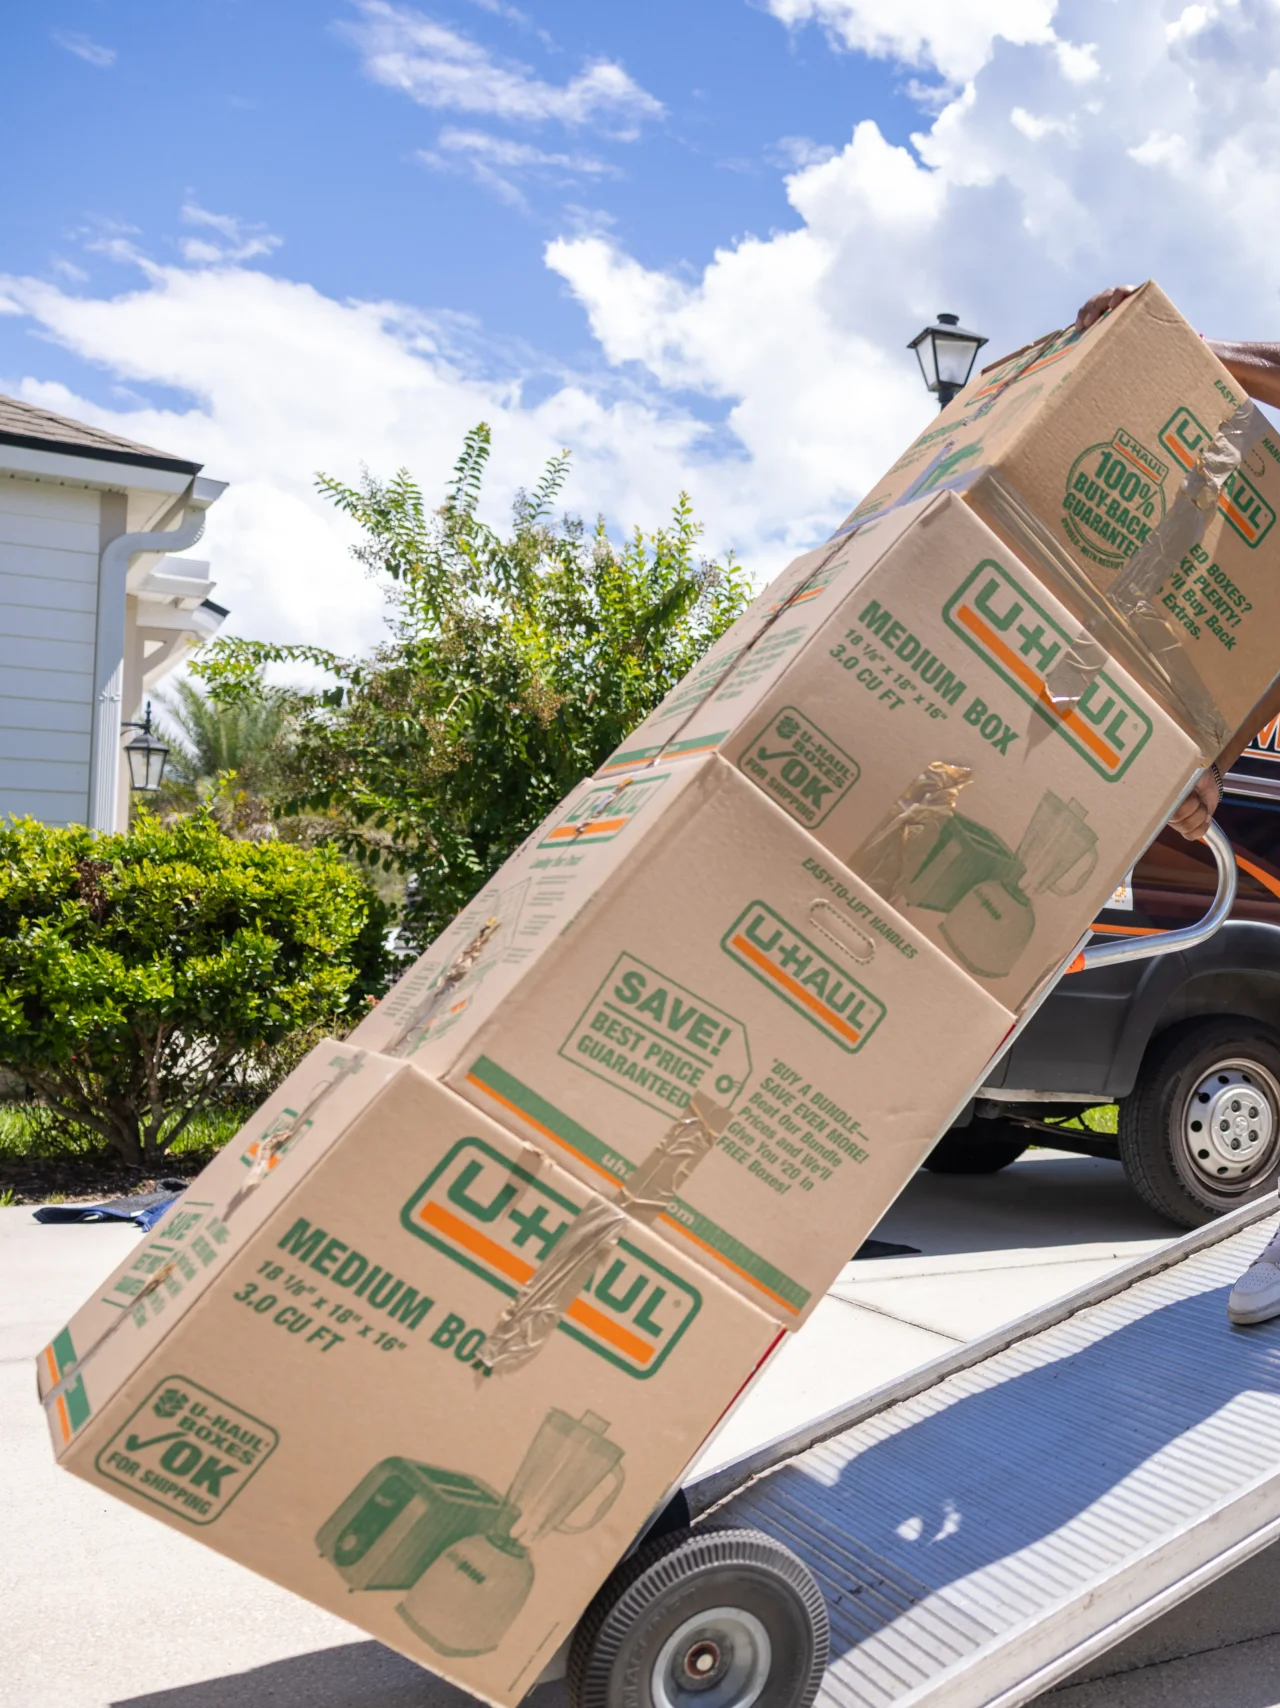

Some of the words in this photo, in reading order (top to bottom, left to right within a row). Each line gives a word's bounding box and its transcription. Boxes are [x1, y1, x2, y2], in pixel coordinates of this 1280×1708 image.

[1214, 379, 1243, 411] EASY-
[1095, 450, 1158, 519] 100%
[1118, 433, 1163, 476] U-HAUL
[1062, 492, 1140, 559] GUARANTE
[1073, 471, 1152, 544] BUY-BACK
[1180, 556, 1198, 577] KE
[1193, 574, 1242, 628] PLENTY!
[1189, 543, 1210, 564] ED
[1206, 563, 1253, 613] BOXES?
[1162, 592, 1201, 640] Extras.
[1182, 588, 1208, 617] Buy
[1204, 614, 1237, 651] Back
[829, 643, 860, 670] 3.0
[856, 668, 884, 691] CU
[877, 688, 905, 710] FT
[844, 628, 864, 646] 18
[881, 665, 894, 676] x
[912, 694, 925, 705] x
[857, 599, 968, 707] MEDIUM
[962, 696, 1019, 757] BOX
[974, 577, 1128, 751] U-HUL
[745, 757, 768, 779] FOR
[767, 777, 816, 822] SHIPPING
[781, 758, 834, 811] OK
[792, 739, 845, 789] BOXES
[800, 730, 850, 781] U-HAUL
[801, 857, 873, 919] EASY-TO-LIFT
[869, 915, 918, 959] HANDLES
[746, 913, 867, 1030] U-HAUL
[614, 970, 732, 1057] SAVE!
[576, 1034, 693, 1109] GUARANTEED
[589, 1010, 646, 1052] BEST
[643, 1041, 705, 1088] PRICE
[759, 1077, 797, 1107] SAVE
[792, 1103, 830, 1133] EVEN
[826, 1128, 870, 1165] MORE!
[797, 1083, 813, 1097] A
[727, 1121, 755, 1146] Give
[755, 1141, 780, 1165] You
[799, 1176, 815, 1192] in
[737, 1106, 777, 1140] Prices
[775, 1137, 804, 1158] and
[801, 1152, 834, 1181] We'll
[748, 1091, 781, 1119] Beat
[777, 1114, 803, 1135] Our
[800, 1131, 843, 1168] Bundle
[716, 1135, 752, 1165] FREE
[747, 1159, 792, 1195] Boxes!
[277, 1217, 435, 1331] MEDIUM
[447, 1158, 667, 1339] U-HUL
[233, 1282, 278, 1315] 3.0
[272, 1305, 313, 1334] CU
[304, 1324, 346, 1353] FT
[257, 1260, 284, 1281] 18
[310, 1296, 328, 1310] x
[327, 1303, 363, 1325] 18"
[356, 1324, 374, 1338] x
[372, 1330, 408, 1353] 16"
[177, 1415, 256, 1466] BOXES
[189, 1401, 264, 1453] U-HAUL
[105, 1451, 141, 1477] FOR
[139, 1468, 213, 1516] SHIPPING
[160, 1440, 239, 1498] OK
